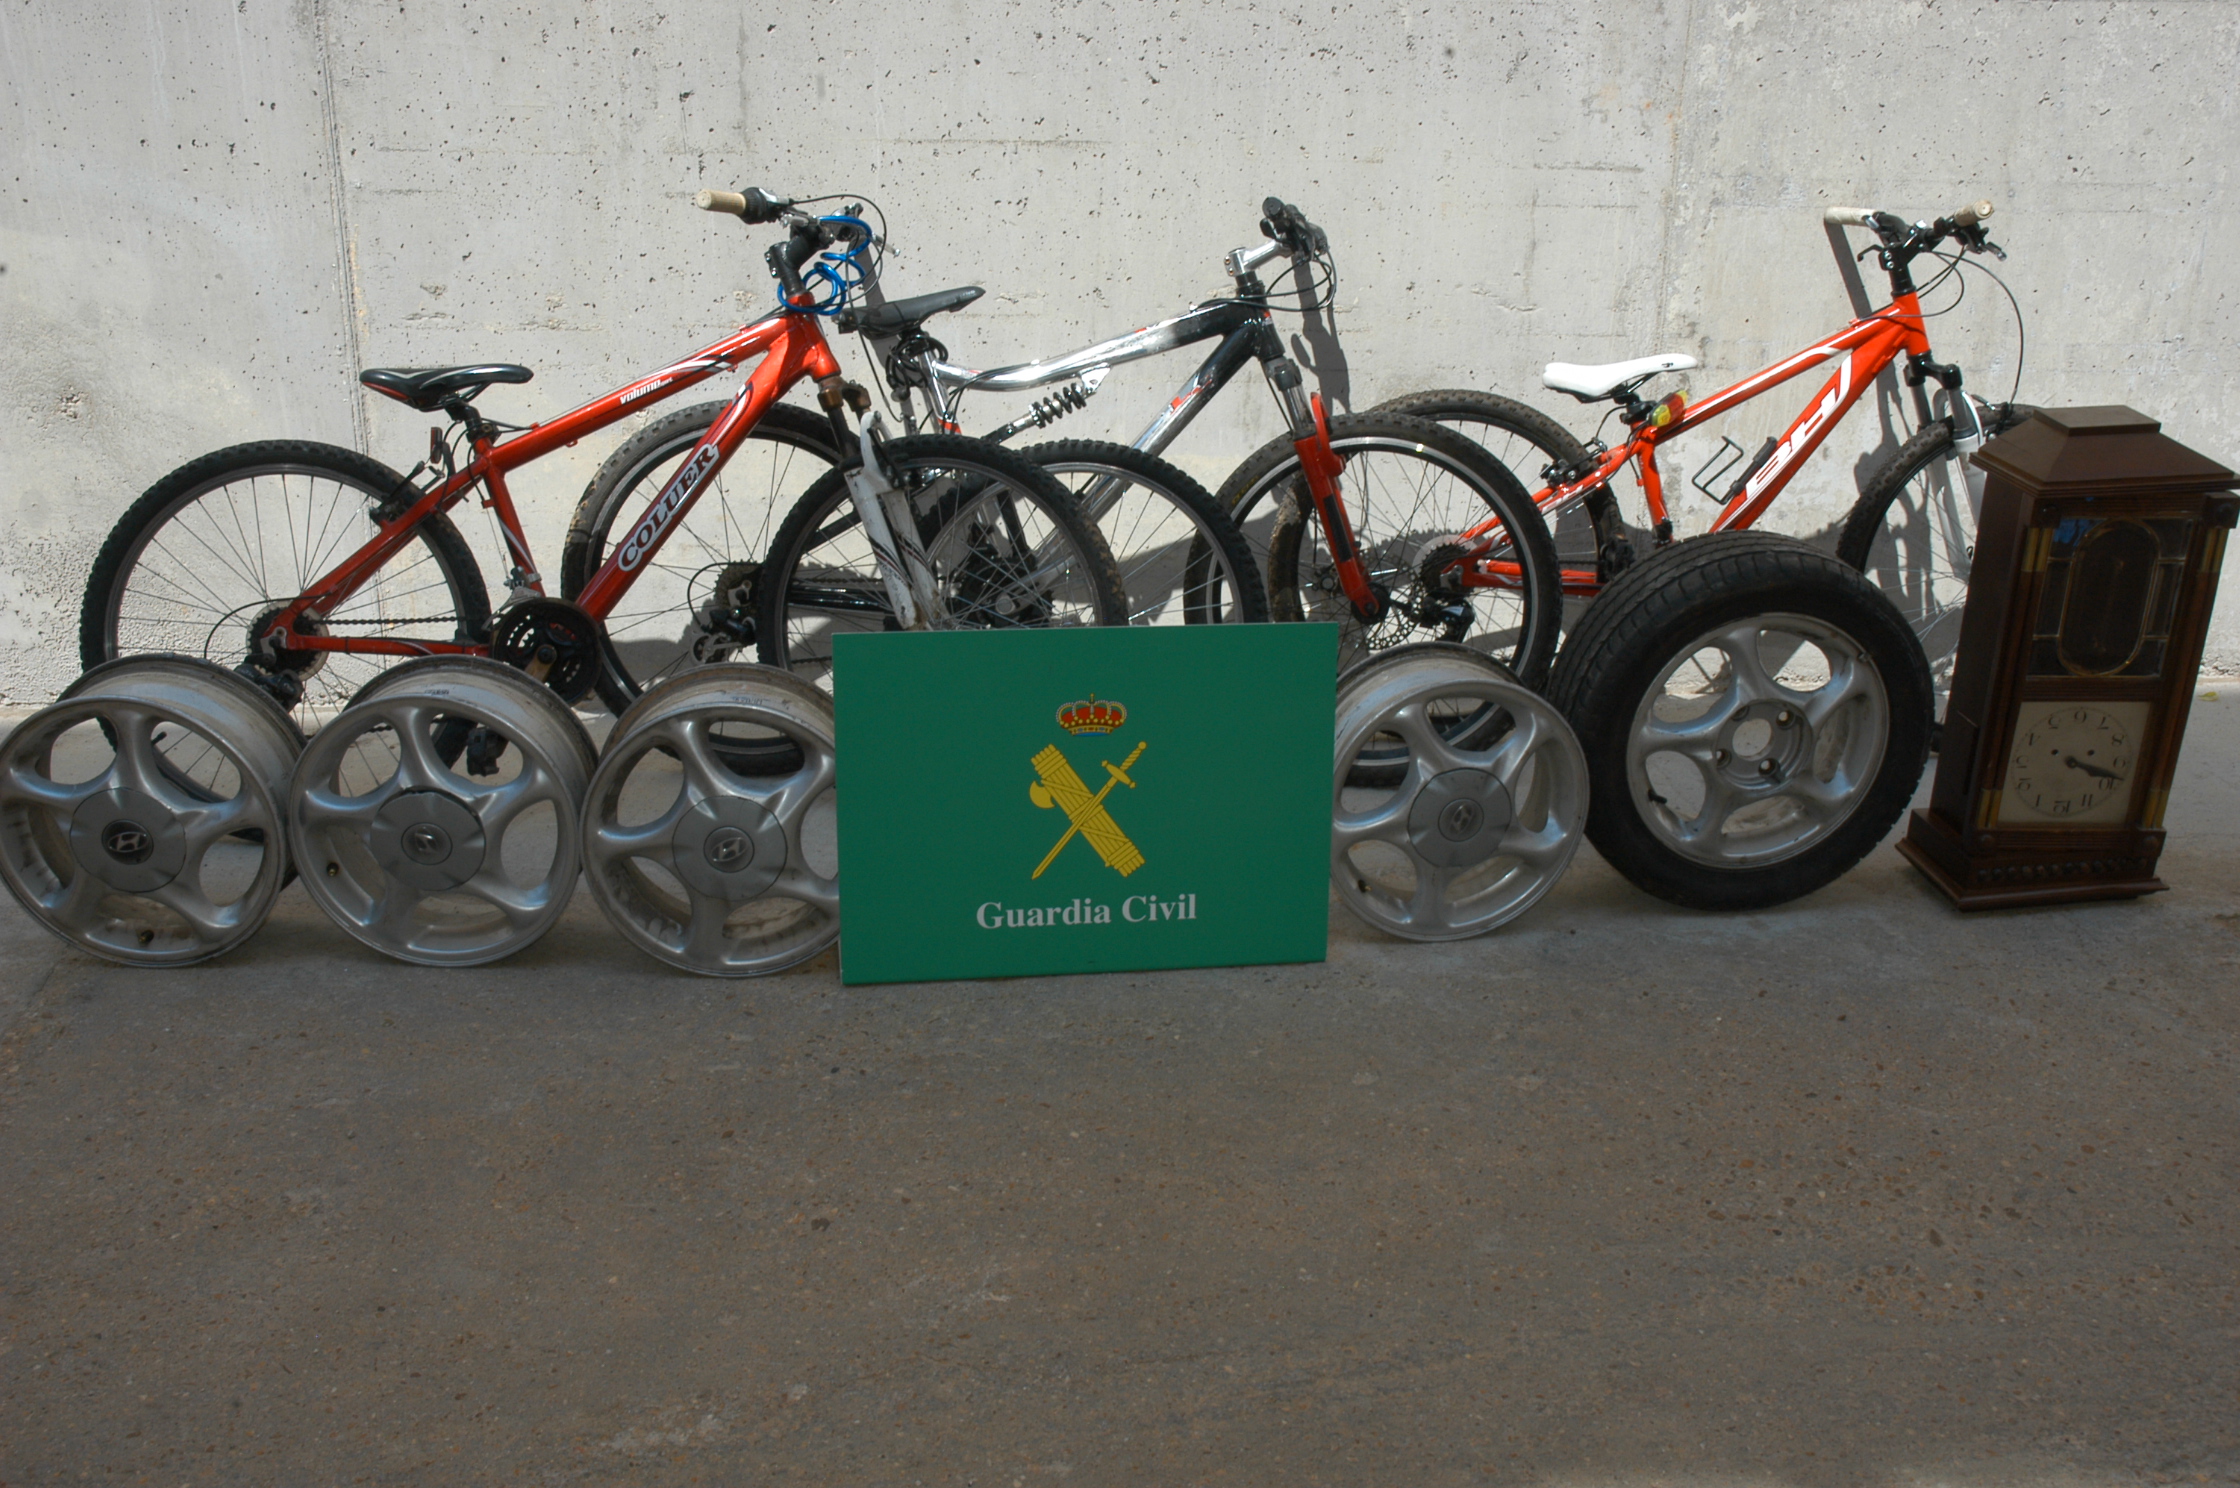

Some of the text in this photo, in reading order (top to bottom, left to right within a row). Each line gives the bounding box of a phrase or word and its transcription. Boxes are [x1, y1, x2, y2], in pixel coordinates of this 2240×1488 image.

[619, 379, 661, 405] volume
[620, 446, 719, 569] COLUER
[976, 893, 1197, 929] Guardia Civil
